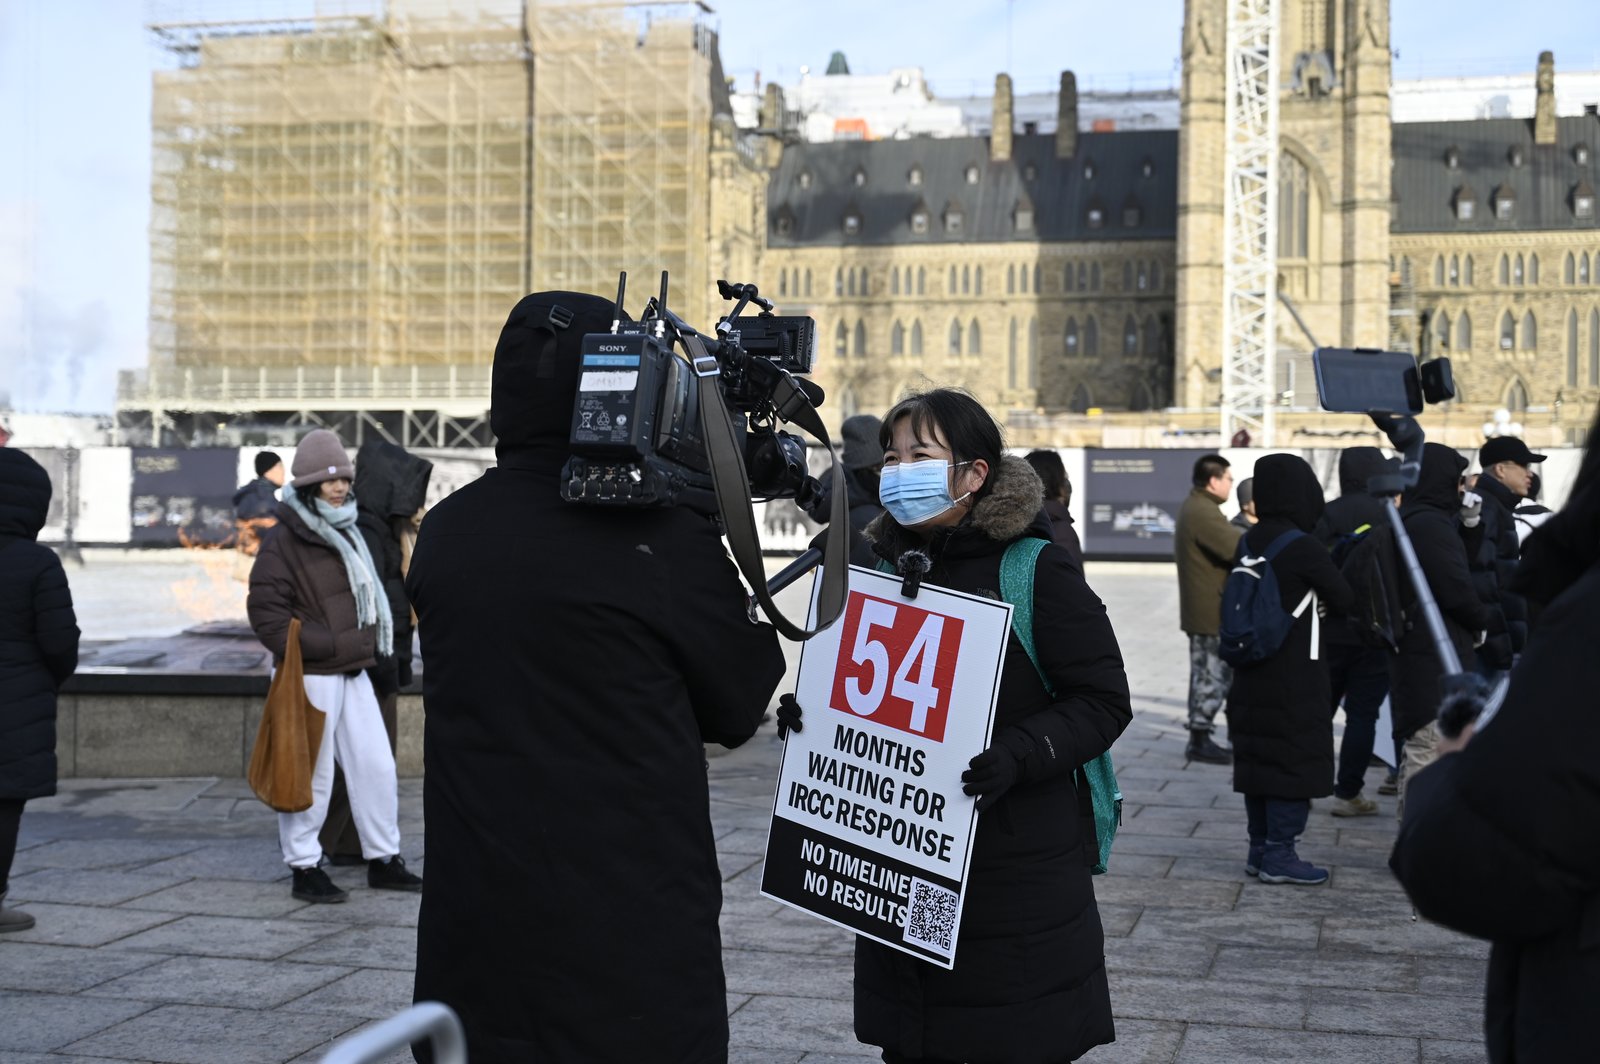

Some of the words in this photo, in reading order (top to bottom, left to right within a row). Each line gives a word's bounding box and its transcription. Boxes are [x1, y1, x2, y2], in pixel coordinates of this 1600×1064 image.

[844, 597, 945, 733] 54
[833, 724, 926, 777] MONTHS
[808, 751, 895, 805] WAITING
[900, 783, 946, 822] FOR
[788, 781, 835, 820] IRCC
[835, 798, 955, 863] RESPONSE
[800, 838, 825, 866] NO
[829, 848, 912, 899] TIMELINE
[803, 869, 828, 897] NO
[831, 880, 908, 928] RESULTS
